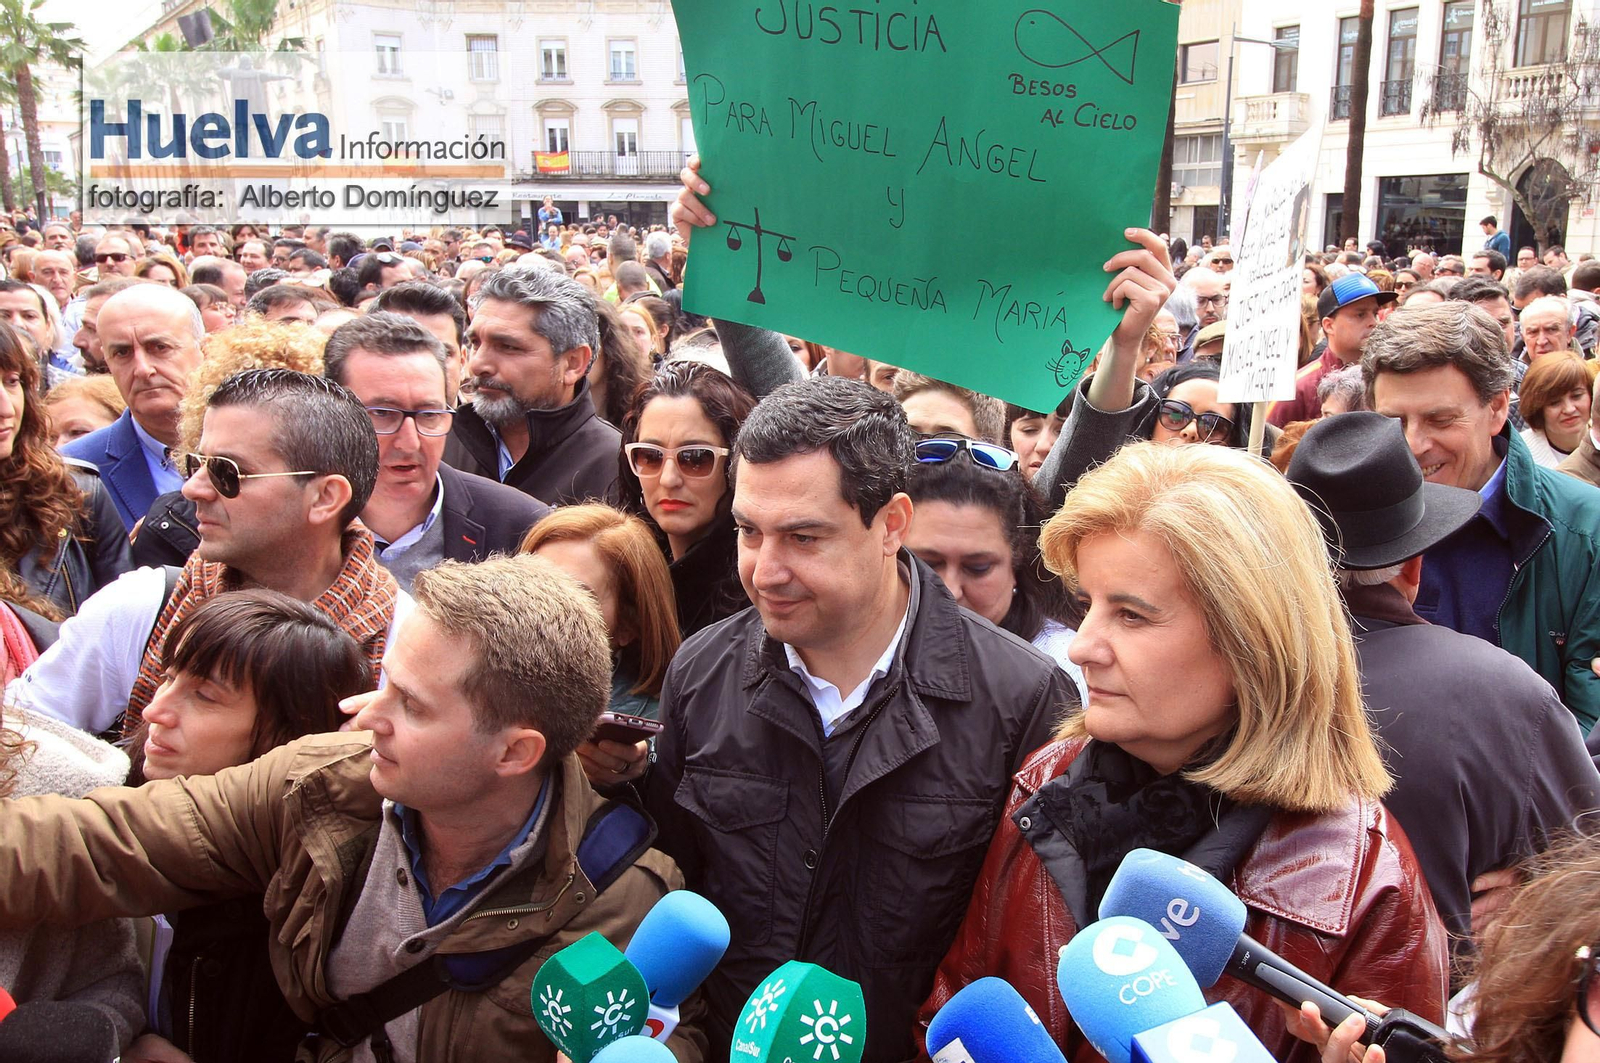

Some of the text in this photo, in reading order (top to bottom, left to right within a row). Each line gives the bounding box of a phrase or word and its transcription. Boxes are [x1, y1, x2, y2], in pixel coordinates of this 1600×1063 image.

[755, 0, 946, 52] JUSTICIA
[1008, 73, 1077, 97] BESOS
[693, 74, 1046, 183] PARA MIGUEL ANGEL
[1041, 103, 1137, 131] AL CIELO
[809, 246, 947, 313] PEQUEÑA
[1119, 969, 1178, 1005] COPE
